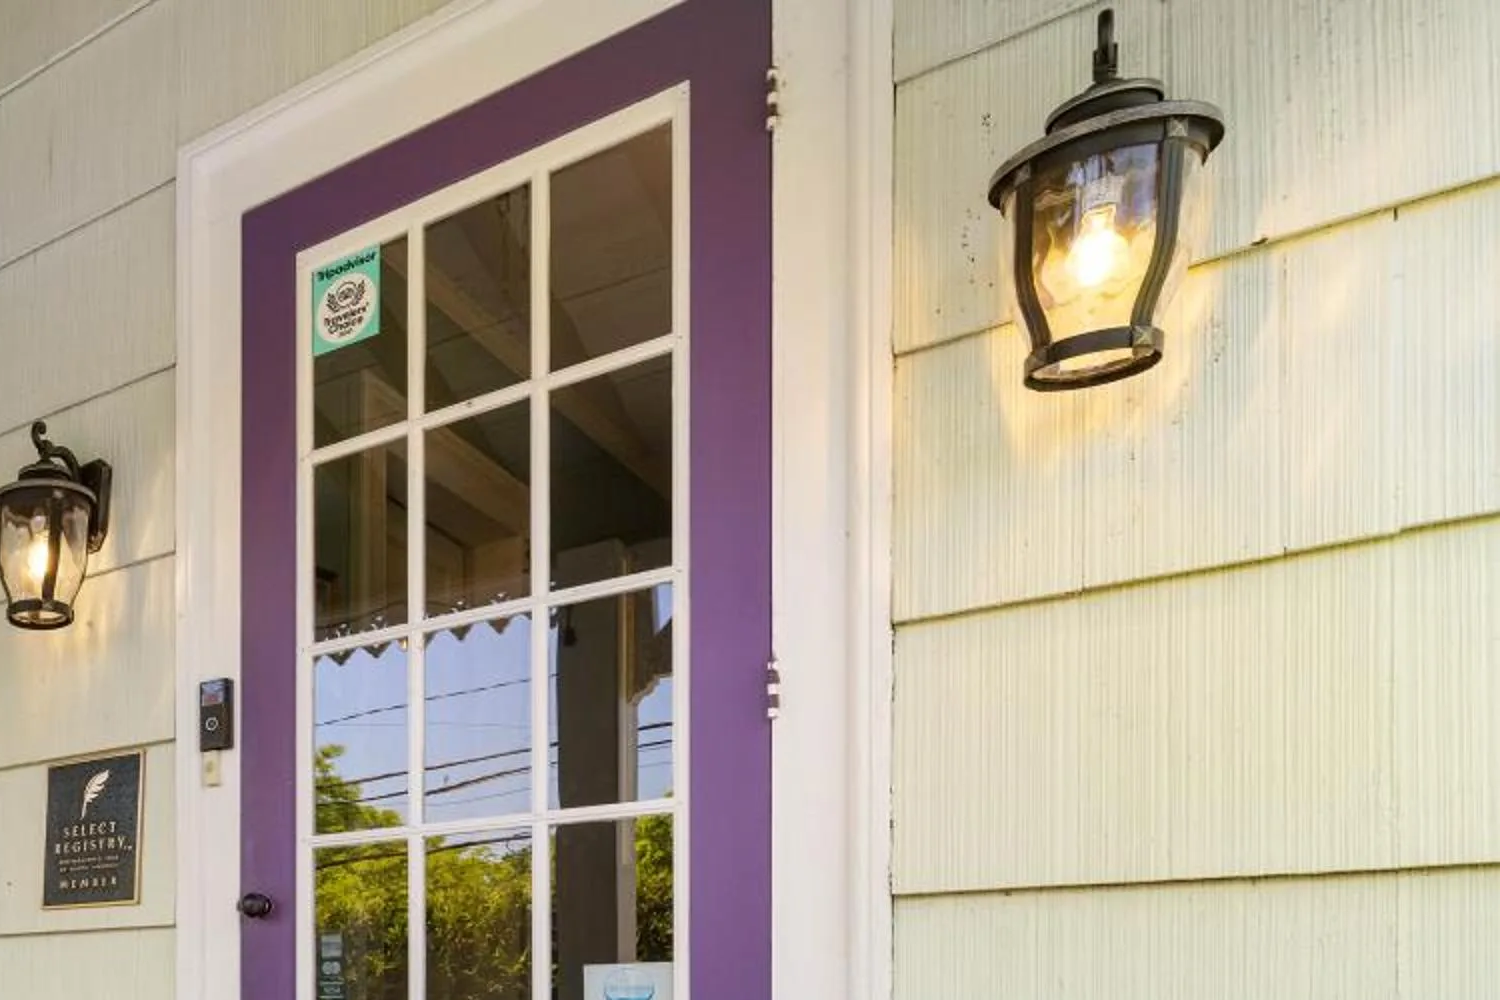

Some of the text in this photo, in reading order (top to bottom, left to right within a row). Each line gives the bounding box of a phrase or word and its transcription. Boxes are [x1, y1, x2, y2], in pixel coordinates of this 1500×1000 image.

[316, 251, 376, 281] Tripadvisor
[327, 315, 364, 335] Choice
[63, 821, 117, 838] SELECT
[55, 835, 126, 854] REGISTRY
[60, 876, 117, 889] MEMBER
